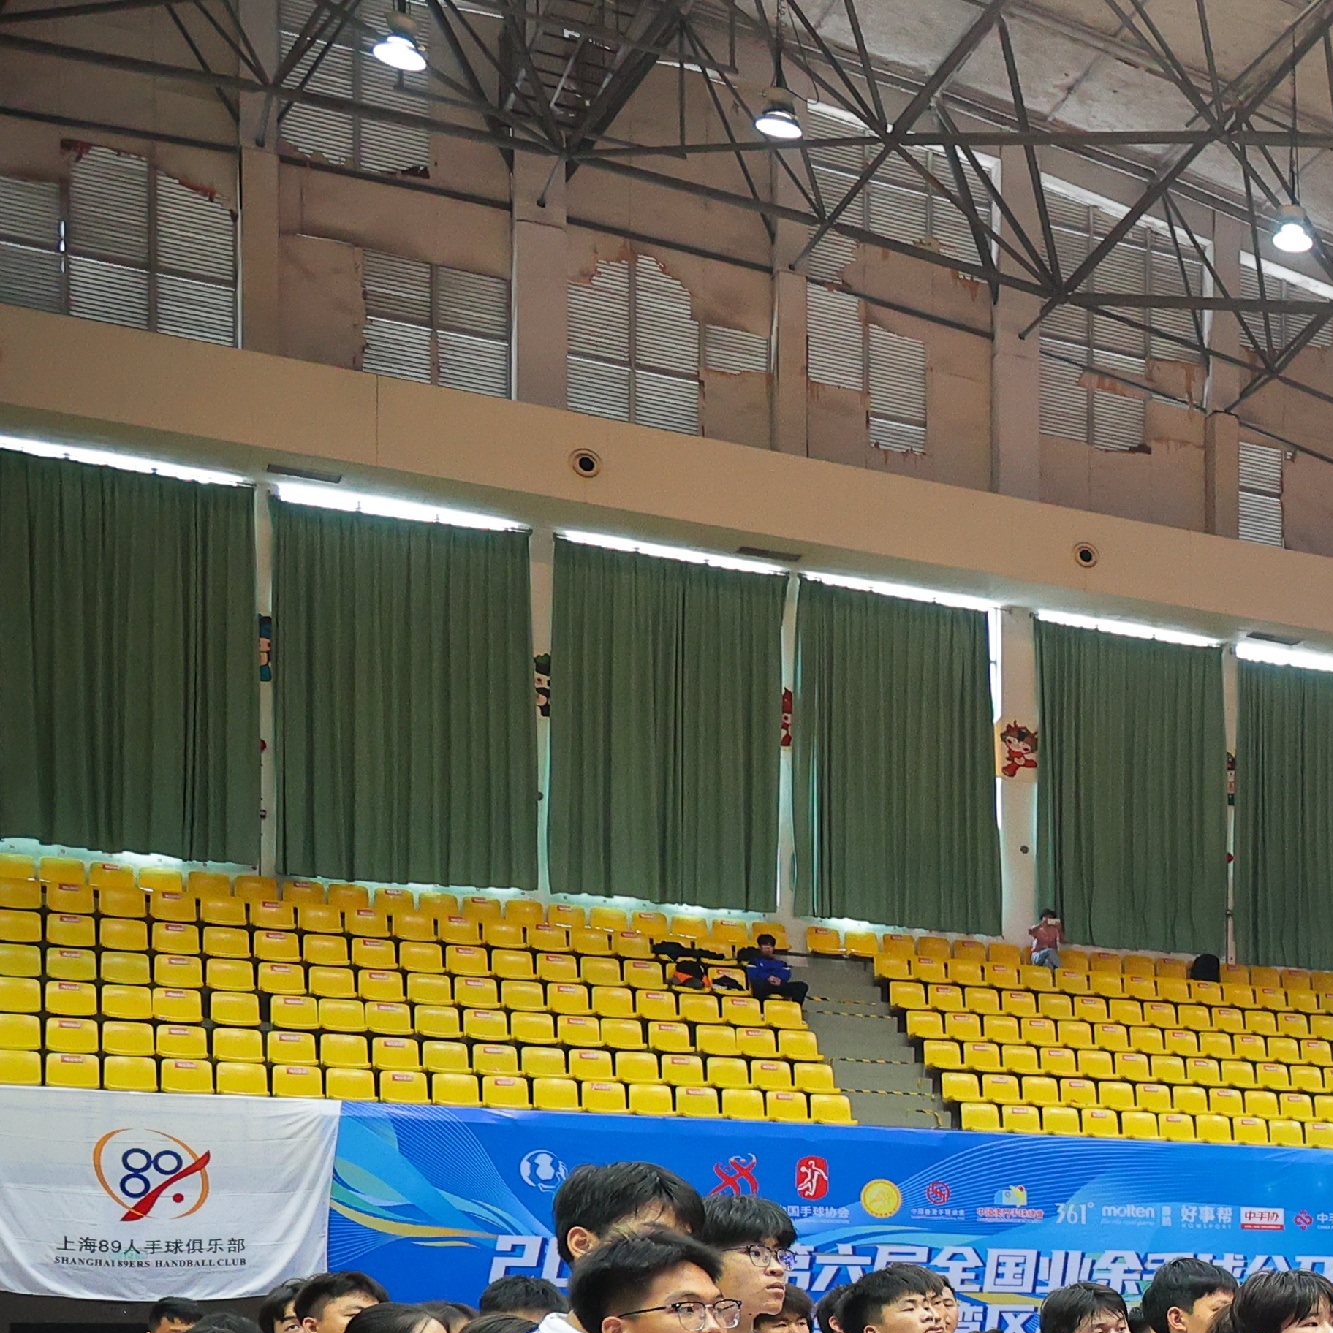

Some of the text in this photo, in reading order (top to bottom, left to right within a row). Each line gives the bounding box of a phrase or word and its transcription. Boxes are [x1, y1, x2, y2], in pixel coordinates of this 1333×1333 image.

[1101, 1204, 1155, 1219] molten
[1180, 1205, 1232, 1224] 好事帮
[1244, 1211, 1280, 1222] 中手协
[56, 1236, 245, 1254] 上海89人手球俱乐部
[54, 1256, 247, 1268] SHANGHAI 89ERS HANDBALL CLUB
